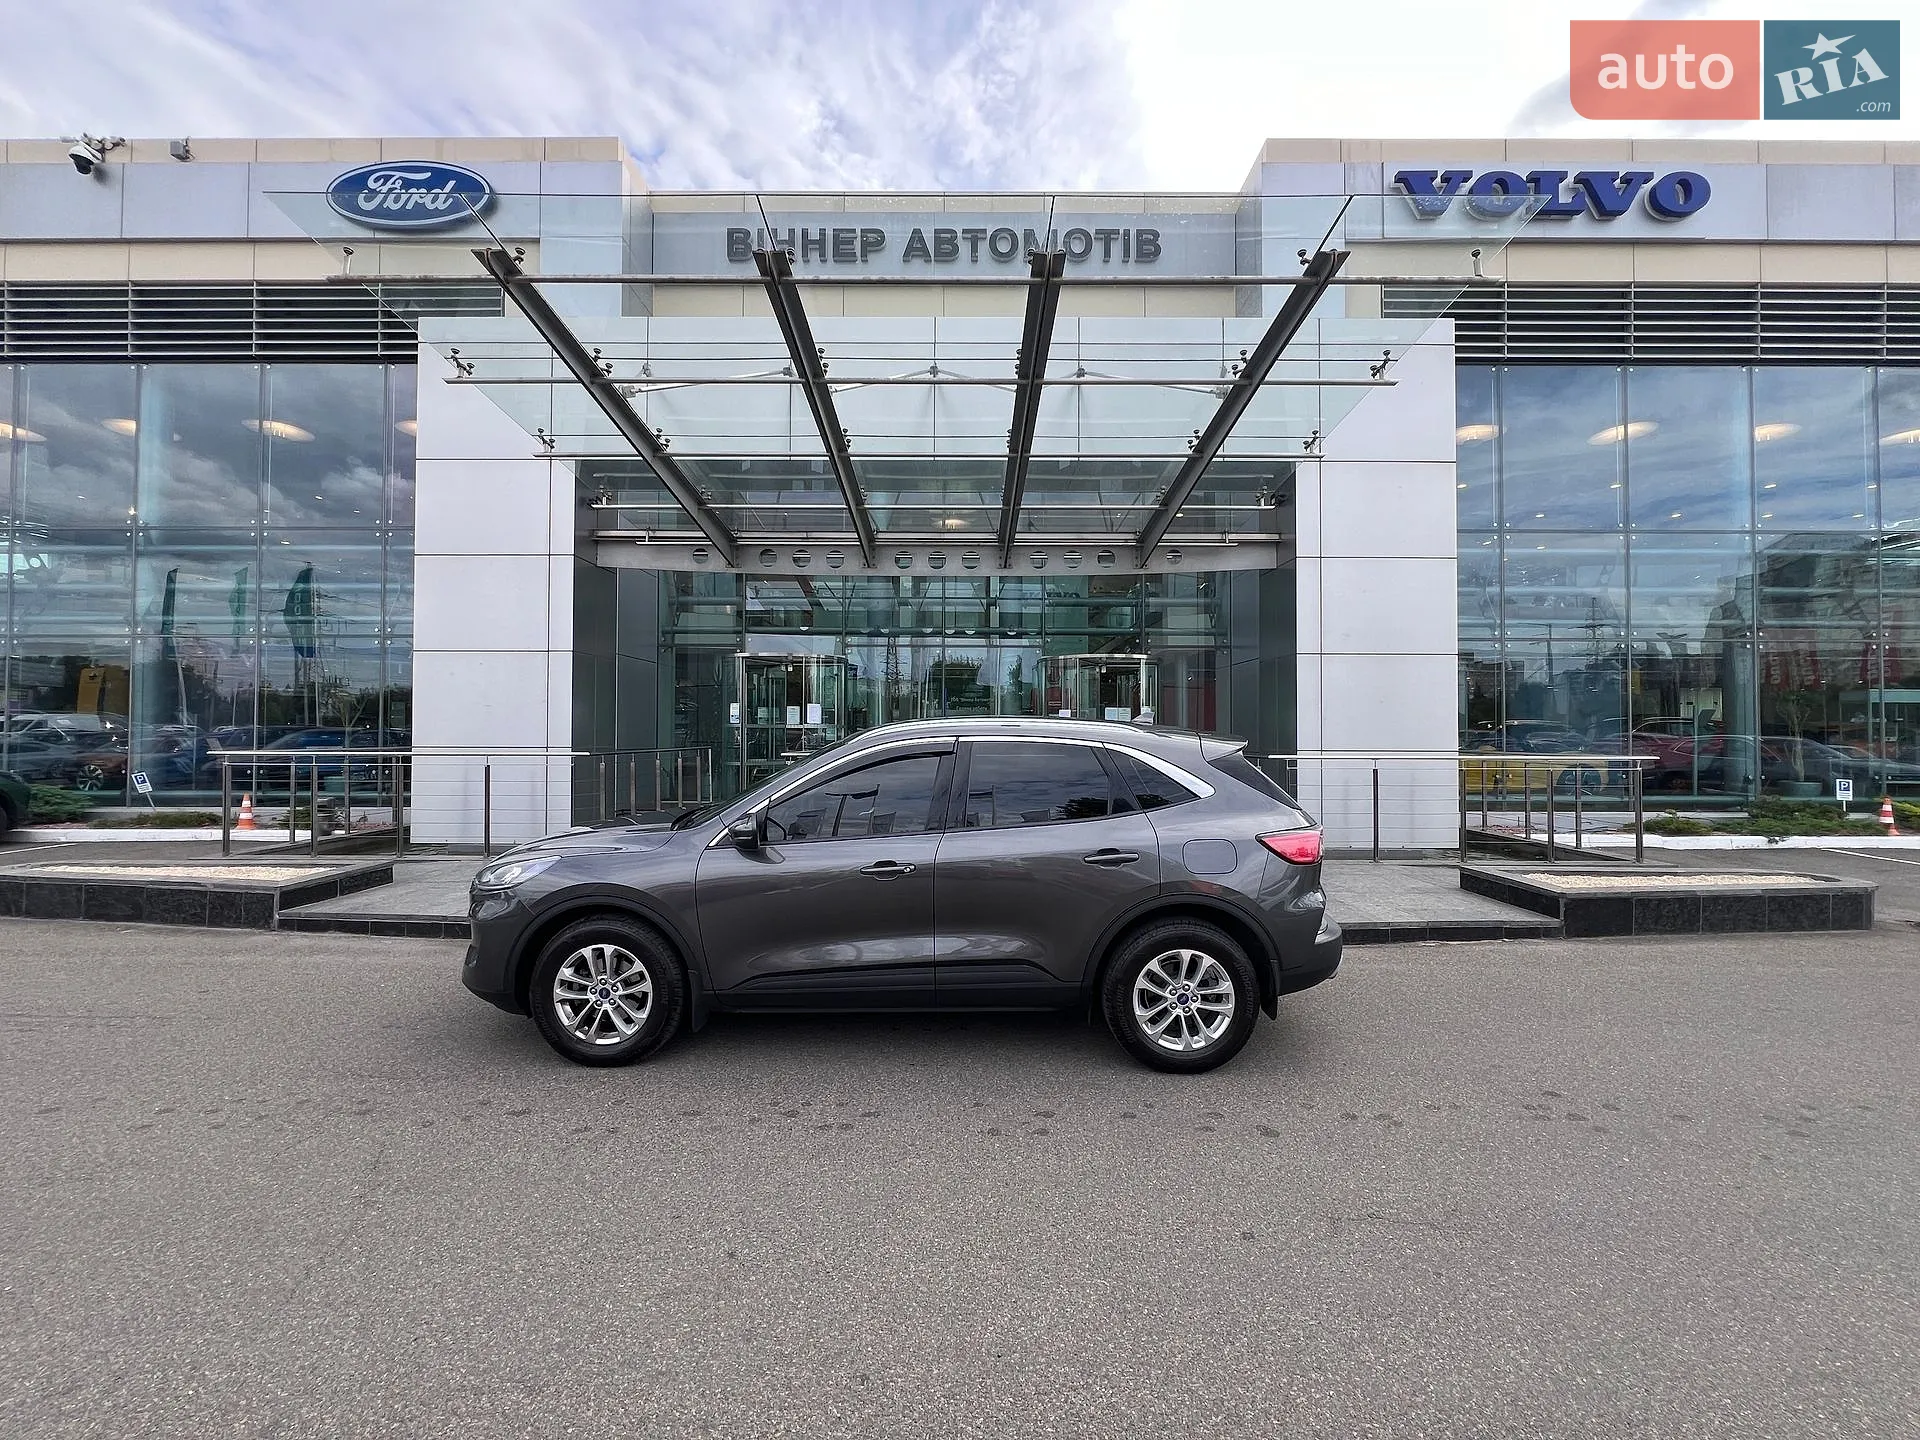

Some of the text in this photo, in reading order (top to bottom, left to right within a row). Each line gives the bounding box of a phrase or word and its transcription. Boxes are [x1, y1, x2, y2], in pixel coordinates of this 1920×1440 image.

[357, 170, 458, 211] Ford
[1393, 170, 1712, 220] VOLVO
[726, 227, 1163, 264] ВІННЕР АВТОМОТІВ
